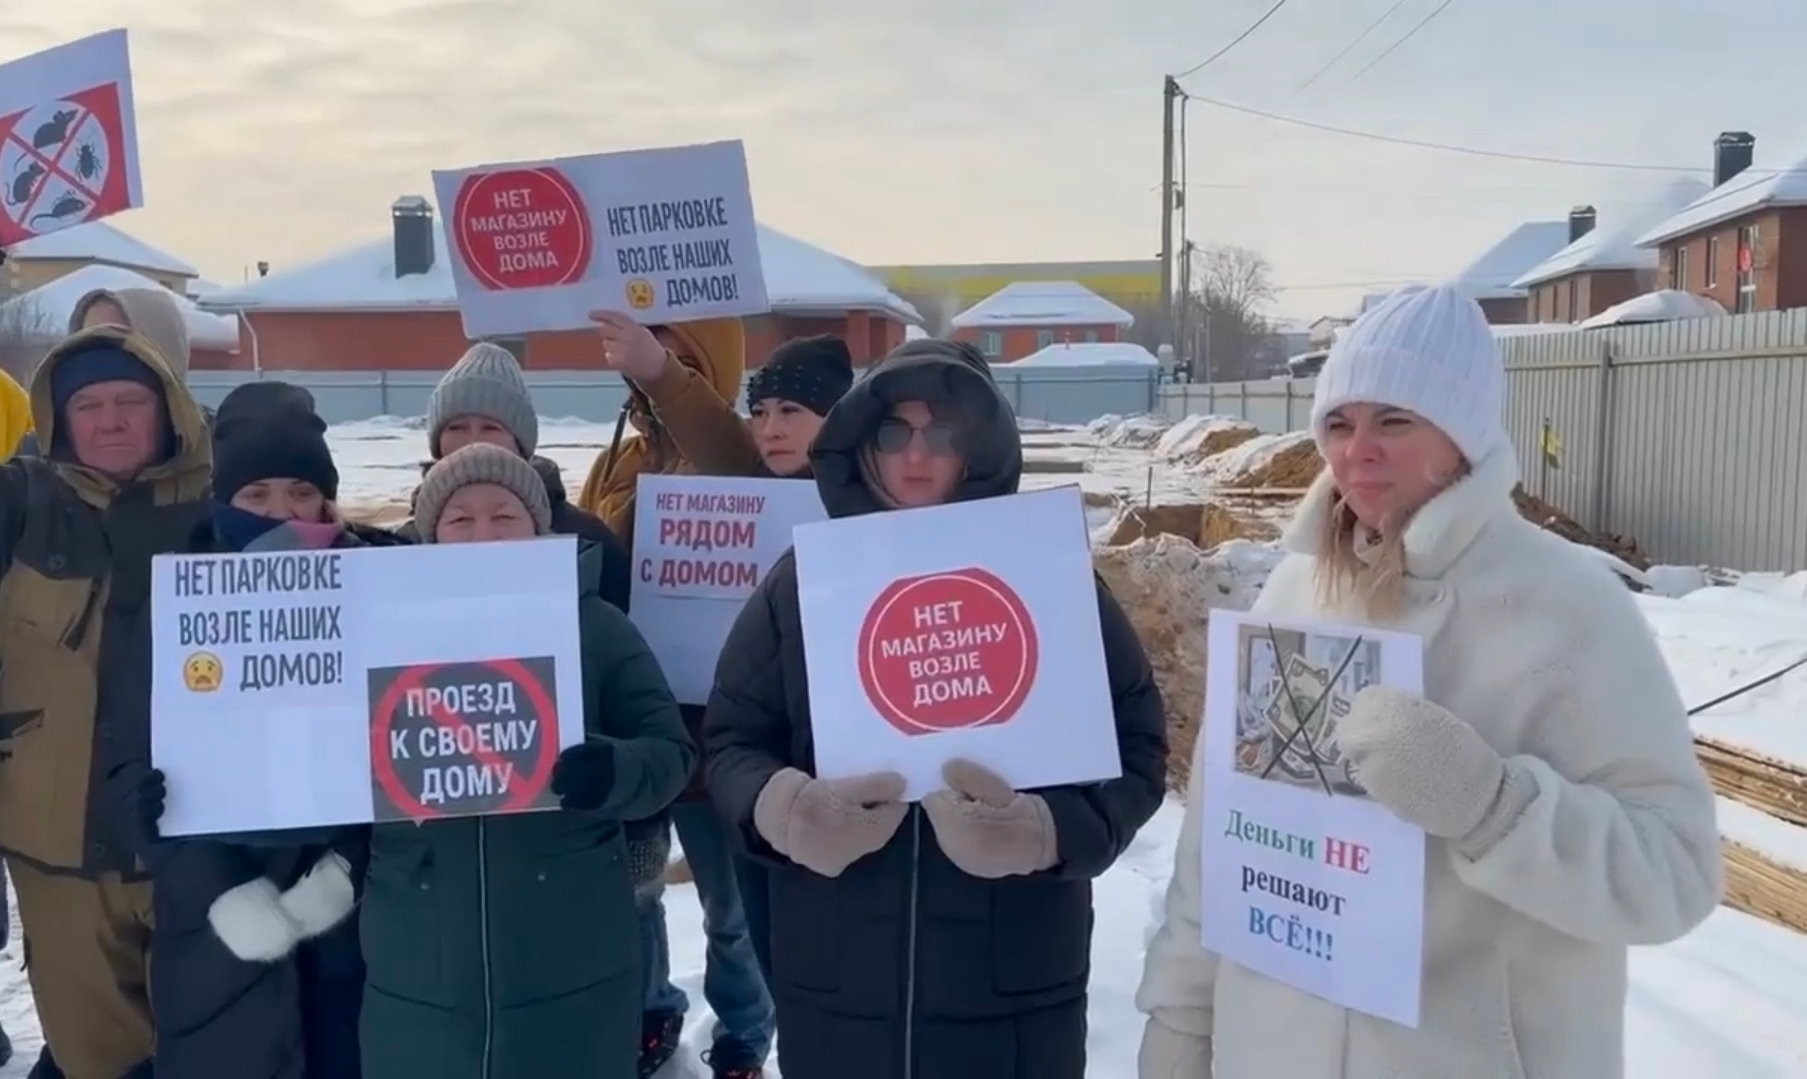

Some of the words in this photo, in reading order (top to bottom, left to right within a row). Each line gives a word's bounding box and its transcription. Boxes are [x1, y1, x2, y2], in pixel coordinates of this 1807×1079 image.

[493, 189, 531, 209] НЕТ
[607, 206, 637, 237] НЕТ
[638, 197, 728, 234] ПАРКОВКЕ
[471, 209, 567, 232] МАГАЗИНУ
[493, 231, 549, 250] ВОЗЛЕ
[616, 244, 671, 274] ВОЗЛЕ
[672, 238, 733, 271] НАШИХ
[500, 250, 559, 273] ДОМА
[666, 274, 739, 308] ДОМОВ!
[656, 493, 684, 511] НЕТ
[687, 494, 766, 514] МАГАЗИНУ
[659, 518, 756, 552] РЯДОМ
[175, 560, 216, 597] НЕТ
[221, 554, 342, 595] ПАРКОВКЕ
[640, 558, 652, 583] С
[659, 559, 758, 588] ДОМОМ
[179, 610, 252, 646] ВОЗЛЕ
[259, 605, 342, 643] НАШИХ
[913, 600, 963, 629] НЕТ
[881, 622, 1007, 659] МАГАЗИНУ
[240, 650, 343, 692] ДОМОВ!
[909, 651, 981, 679] ВОЗЛЕ
[406, 681, 516, 718] ПРОЕЗД
[913, 675, 993, 709] ДОМА
[390, 728, 411, 760] К
[418, 719, 537, 759] СВОЕМУ
[420, 761, 514, 806] ДОМУ
[1224, 808, 1315, 860] Деньги
[1325, 836, 1371, 875] НЕ
[1242, 865, 1346, 916] решают
[1249, 905, 1333, 961] ВСЁ!!!
